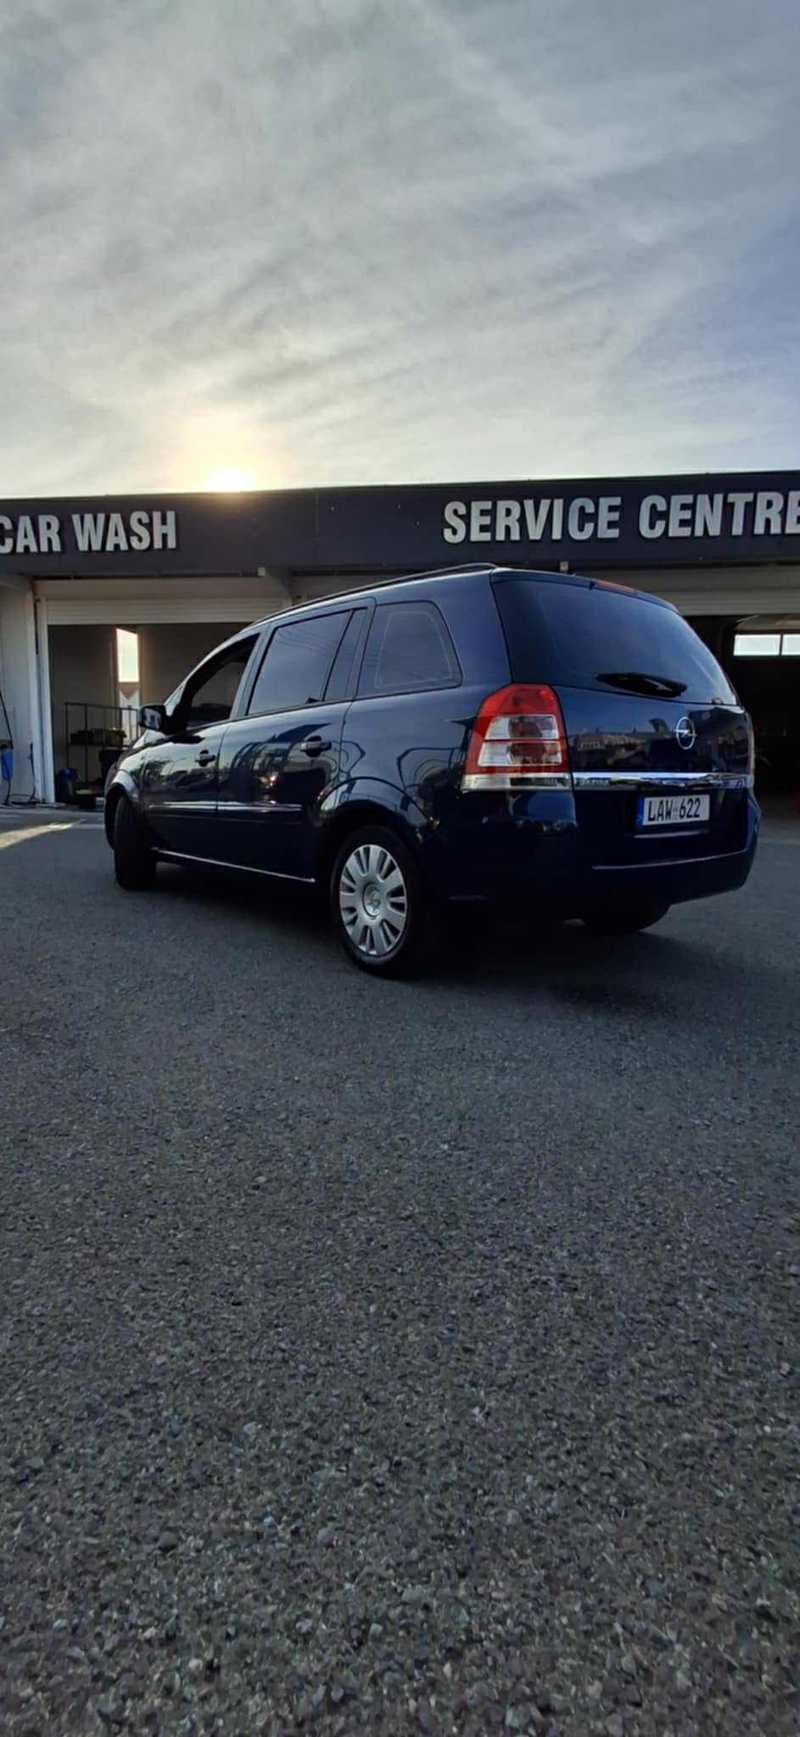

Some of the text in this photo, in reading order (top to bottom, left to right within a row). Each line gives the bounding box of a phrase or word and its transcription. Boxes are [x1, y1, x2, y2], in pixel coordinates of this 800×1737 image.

[71, 510, 176, 552] WASH
[443, 491, 800, 543] SERVICE CENTRE
[648, 798, 700, 821] LAW 622
